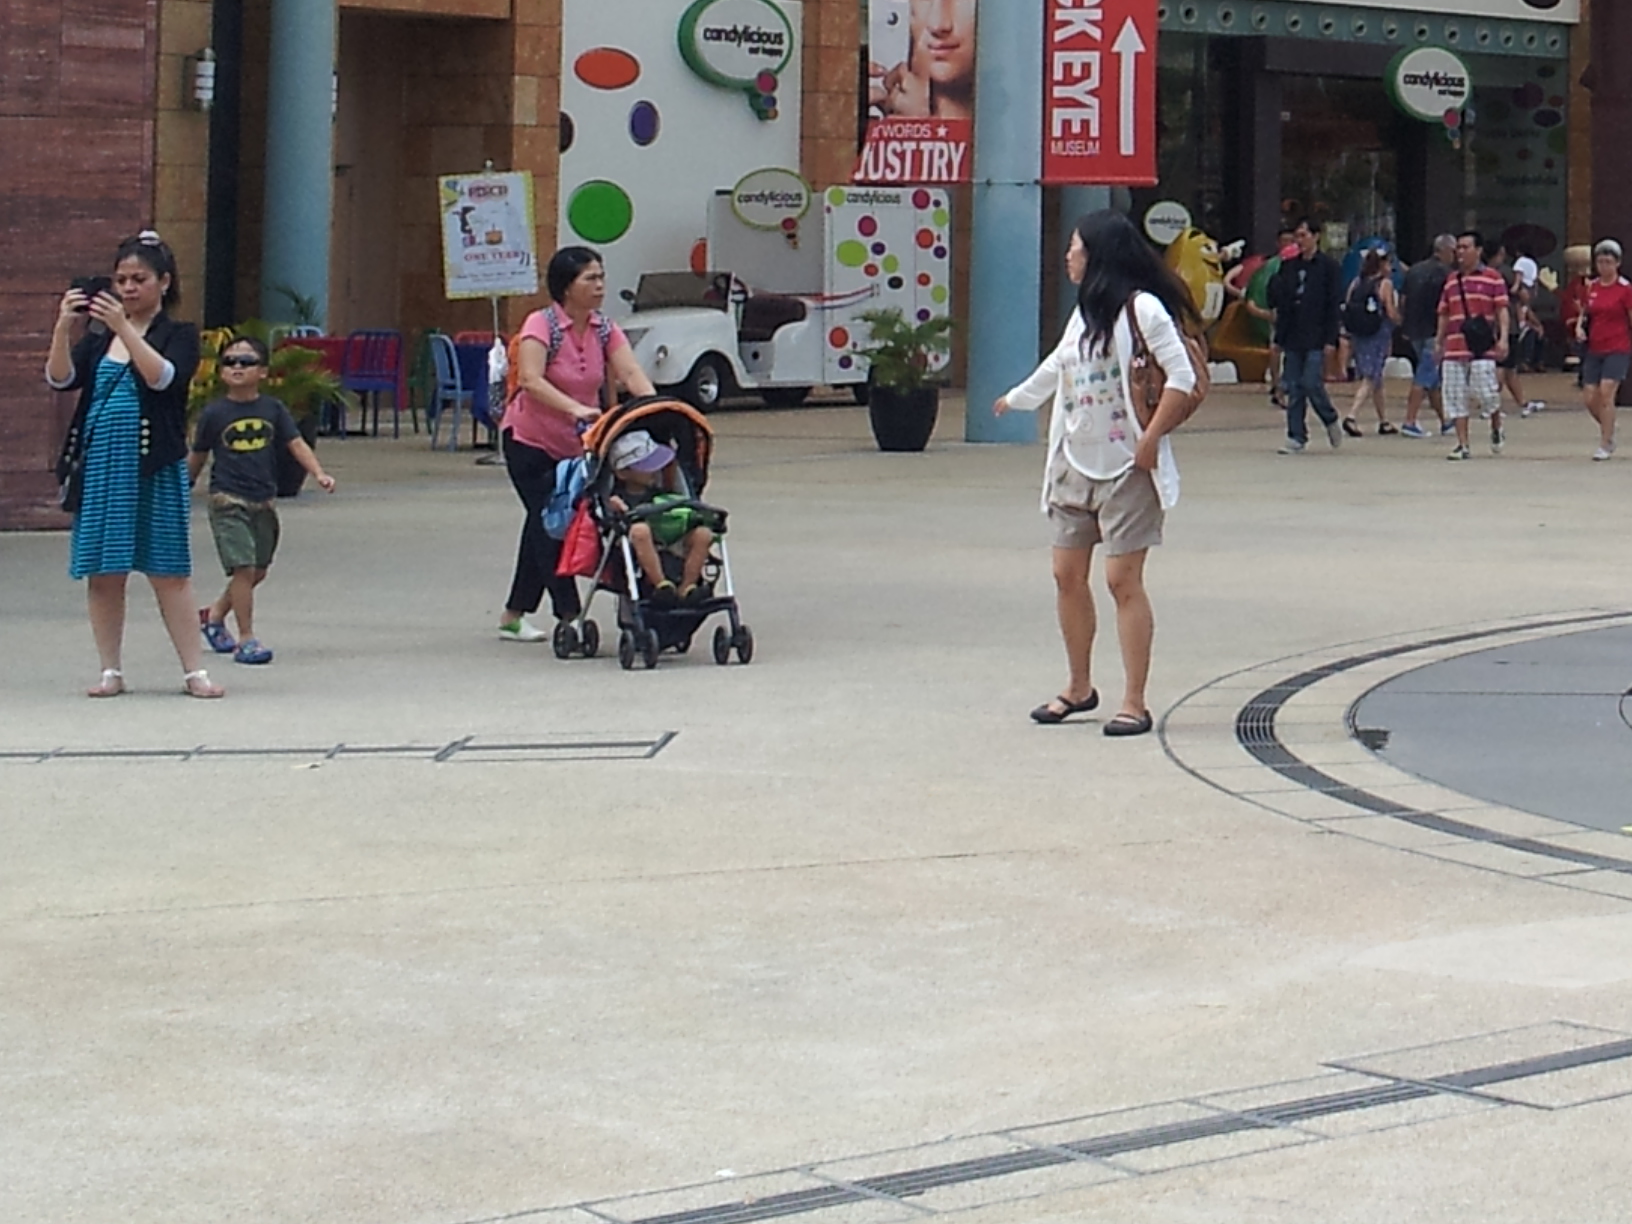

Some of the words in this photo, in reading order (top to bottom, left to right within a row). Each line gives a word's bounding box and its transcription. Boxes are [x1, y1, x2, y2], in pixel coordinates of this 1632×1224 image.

[703, 24, 784, 47] candylicious
[1403, 70, 1465, 90] candylicious
[1052, 50, 1100, 138] EYE
[884, 123, 931, 138] WORDS
[1051, 140, 1100, 155] MUSEUM
[854, 140, 917, 181] JUST
[919, 140, 966, 182] TRY
[737, 189, 803, 205] candylicious
